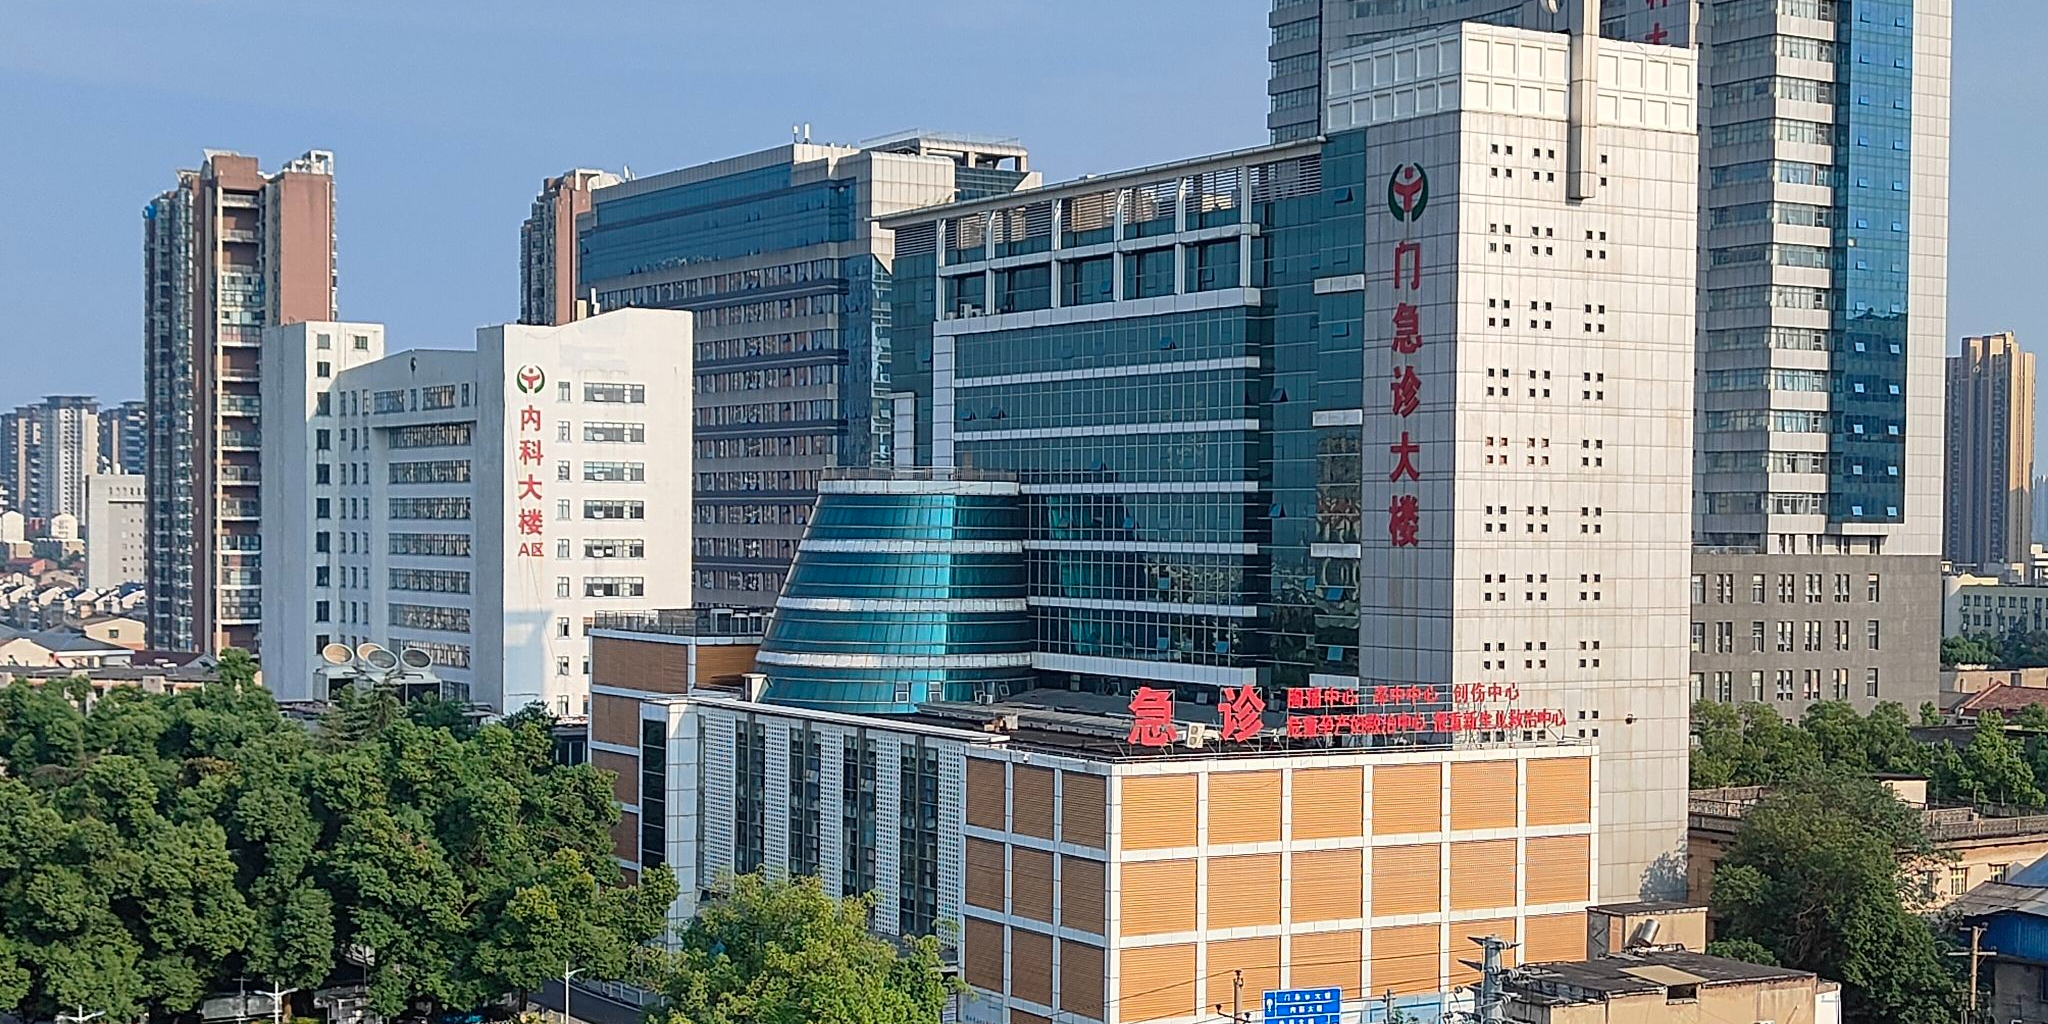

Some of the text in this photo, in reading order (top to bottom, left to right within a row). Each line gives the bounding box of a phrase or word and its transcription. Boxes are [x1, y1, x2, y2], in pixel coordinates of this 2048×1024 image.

[1389, 241, 1422, 547] 门急诊大楼
[518, 405, 544, 535] 内科大楼
[517, 542, 544, 558] A区
[1127, 684, 1266, 747] 急诊
[1453, 682, 1520, 704] 创伤中心
